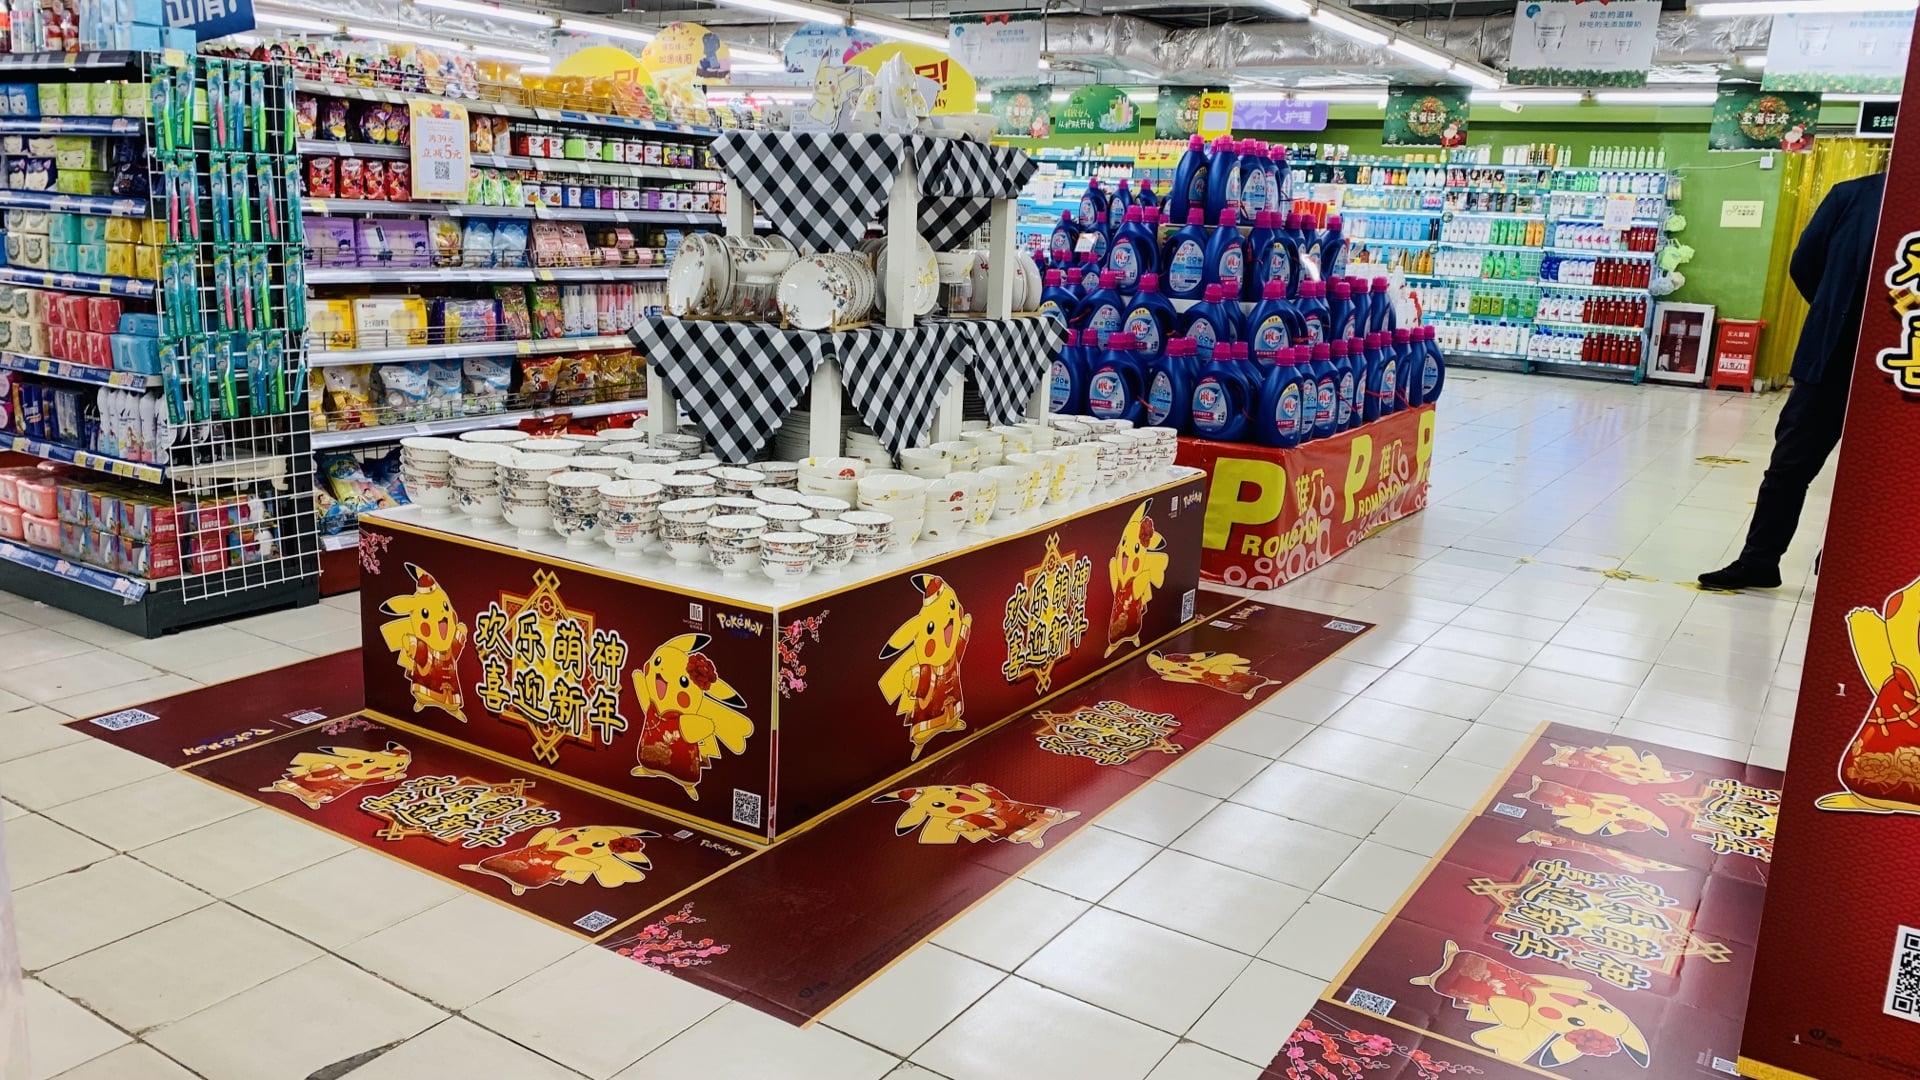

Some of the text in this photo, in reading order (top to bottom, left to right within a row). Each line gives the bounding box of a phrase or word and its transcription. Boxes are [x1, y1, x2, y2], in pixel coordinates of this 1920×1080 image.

[1260, 111, 1312, 125] 个人护理
[1741, 112, 1790, 125] 圣诞狂欢
[1872, 116, 1896, 128] 安全出
[1003, 555, 1091, 629] 欢乐萌神
[474, 602, 628, 686] 欢乐萌神
[1002, 604, 1089, 681] 喜迎新年
[476, 656, 629, 745] 喜迎新年
[1492, 859, 1609, 960] 喜迎新年
[1569, 874, 1680, 990] 欢乐萌神
